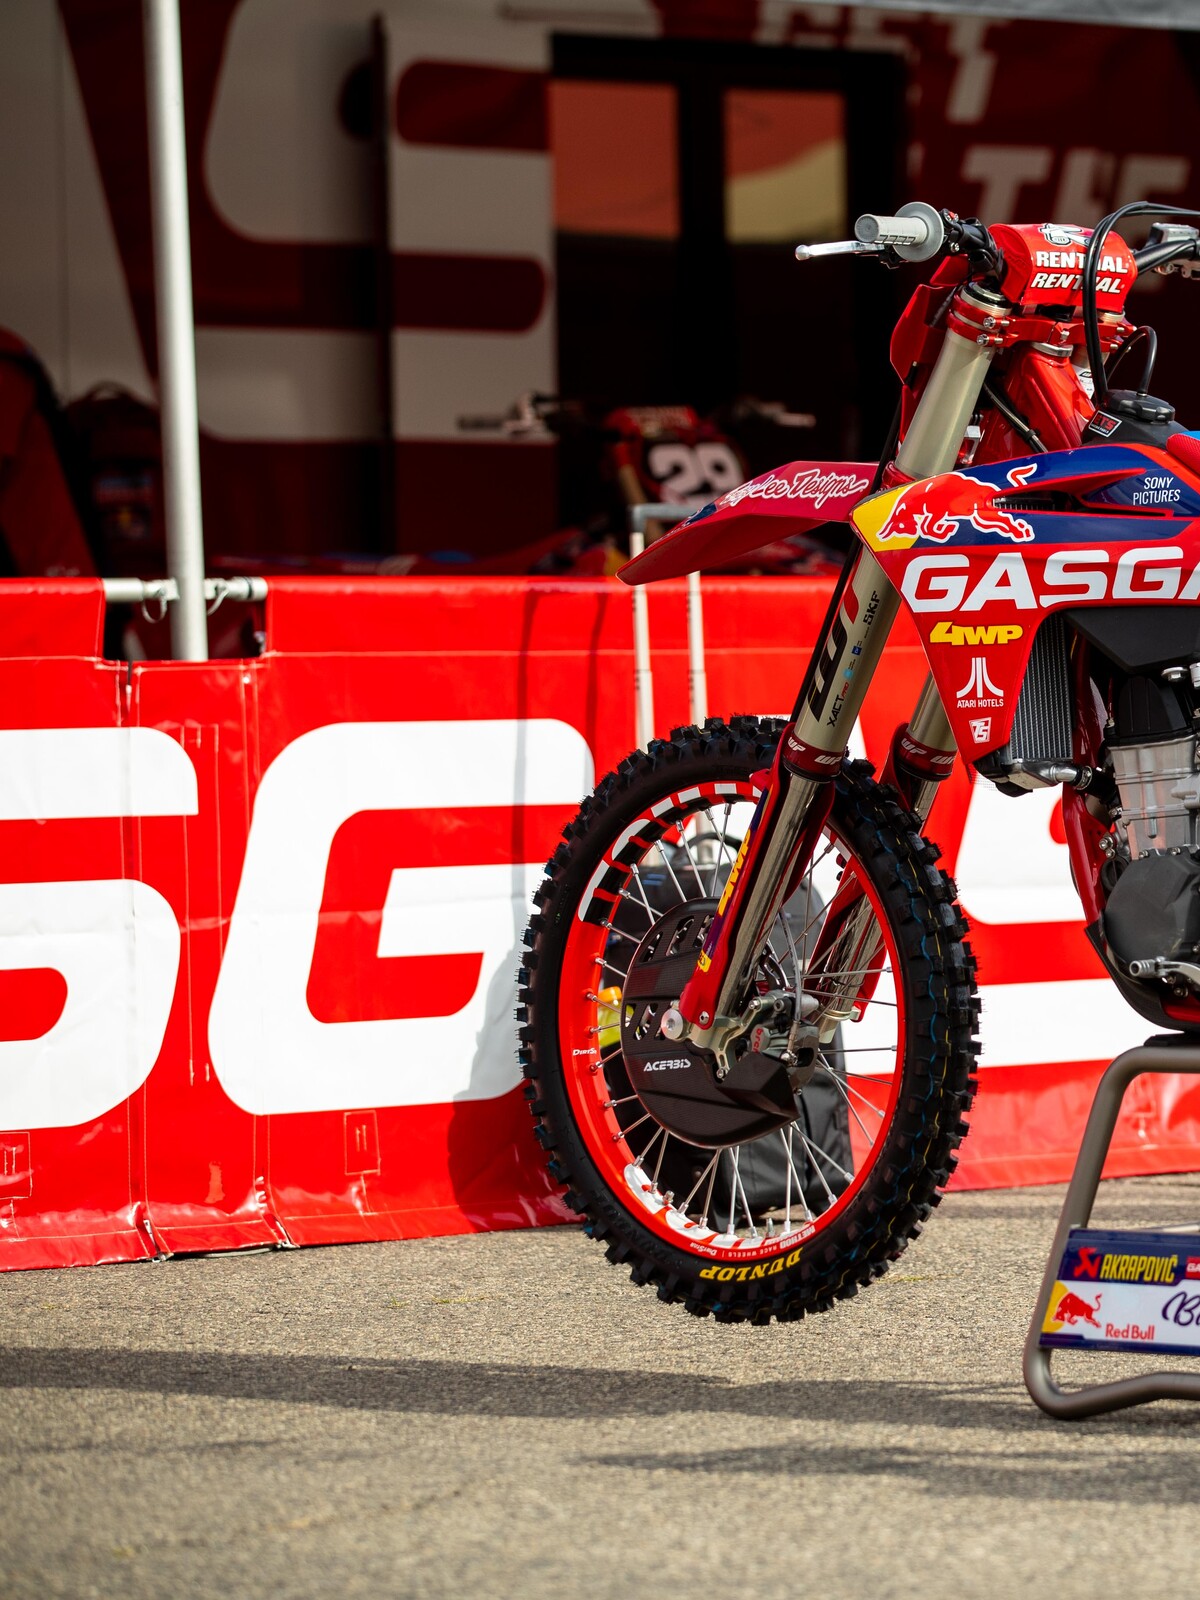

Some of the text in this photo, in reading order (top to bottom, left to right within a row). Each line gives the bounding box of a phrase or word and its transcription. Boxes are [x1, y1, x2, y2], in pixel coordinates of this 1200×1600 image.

[1036, 251, 1128, 274] RENTAL
[1030, 272, 1121, 294] RENTAL
[648, 442, 745, 505] 29
[1143, 476, 1174, 490] SONY
[1132, 489, 1181, 506] PICTURES
[863, 591, 880, 625] SKF
[930, 621, 1023, 646] 4WP
[827, 694, 846, 727] XACT
[957, 699, 1004, 708] ATARI HOTELS
[643, 1059, 692, 1072] ACERBIS
[699, 1247, 804, 1281] DUNLOP
[1099, 1253, 1178, 1284] AKRAPOVIČ
[1105, 1323, 1155, 1341] Red Bull
